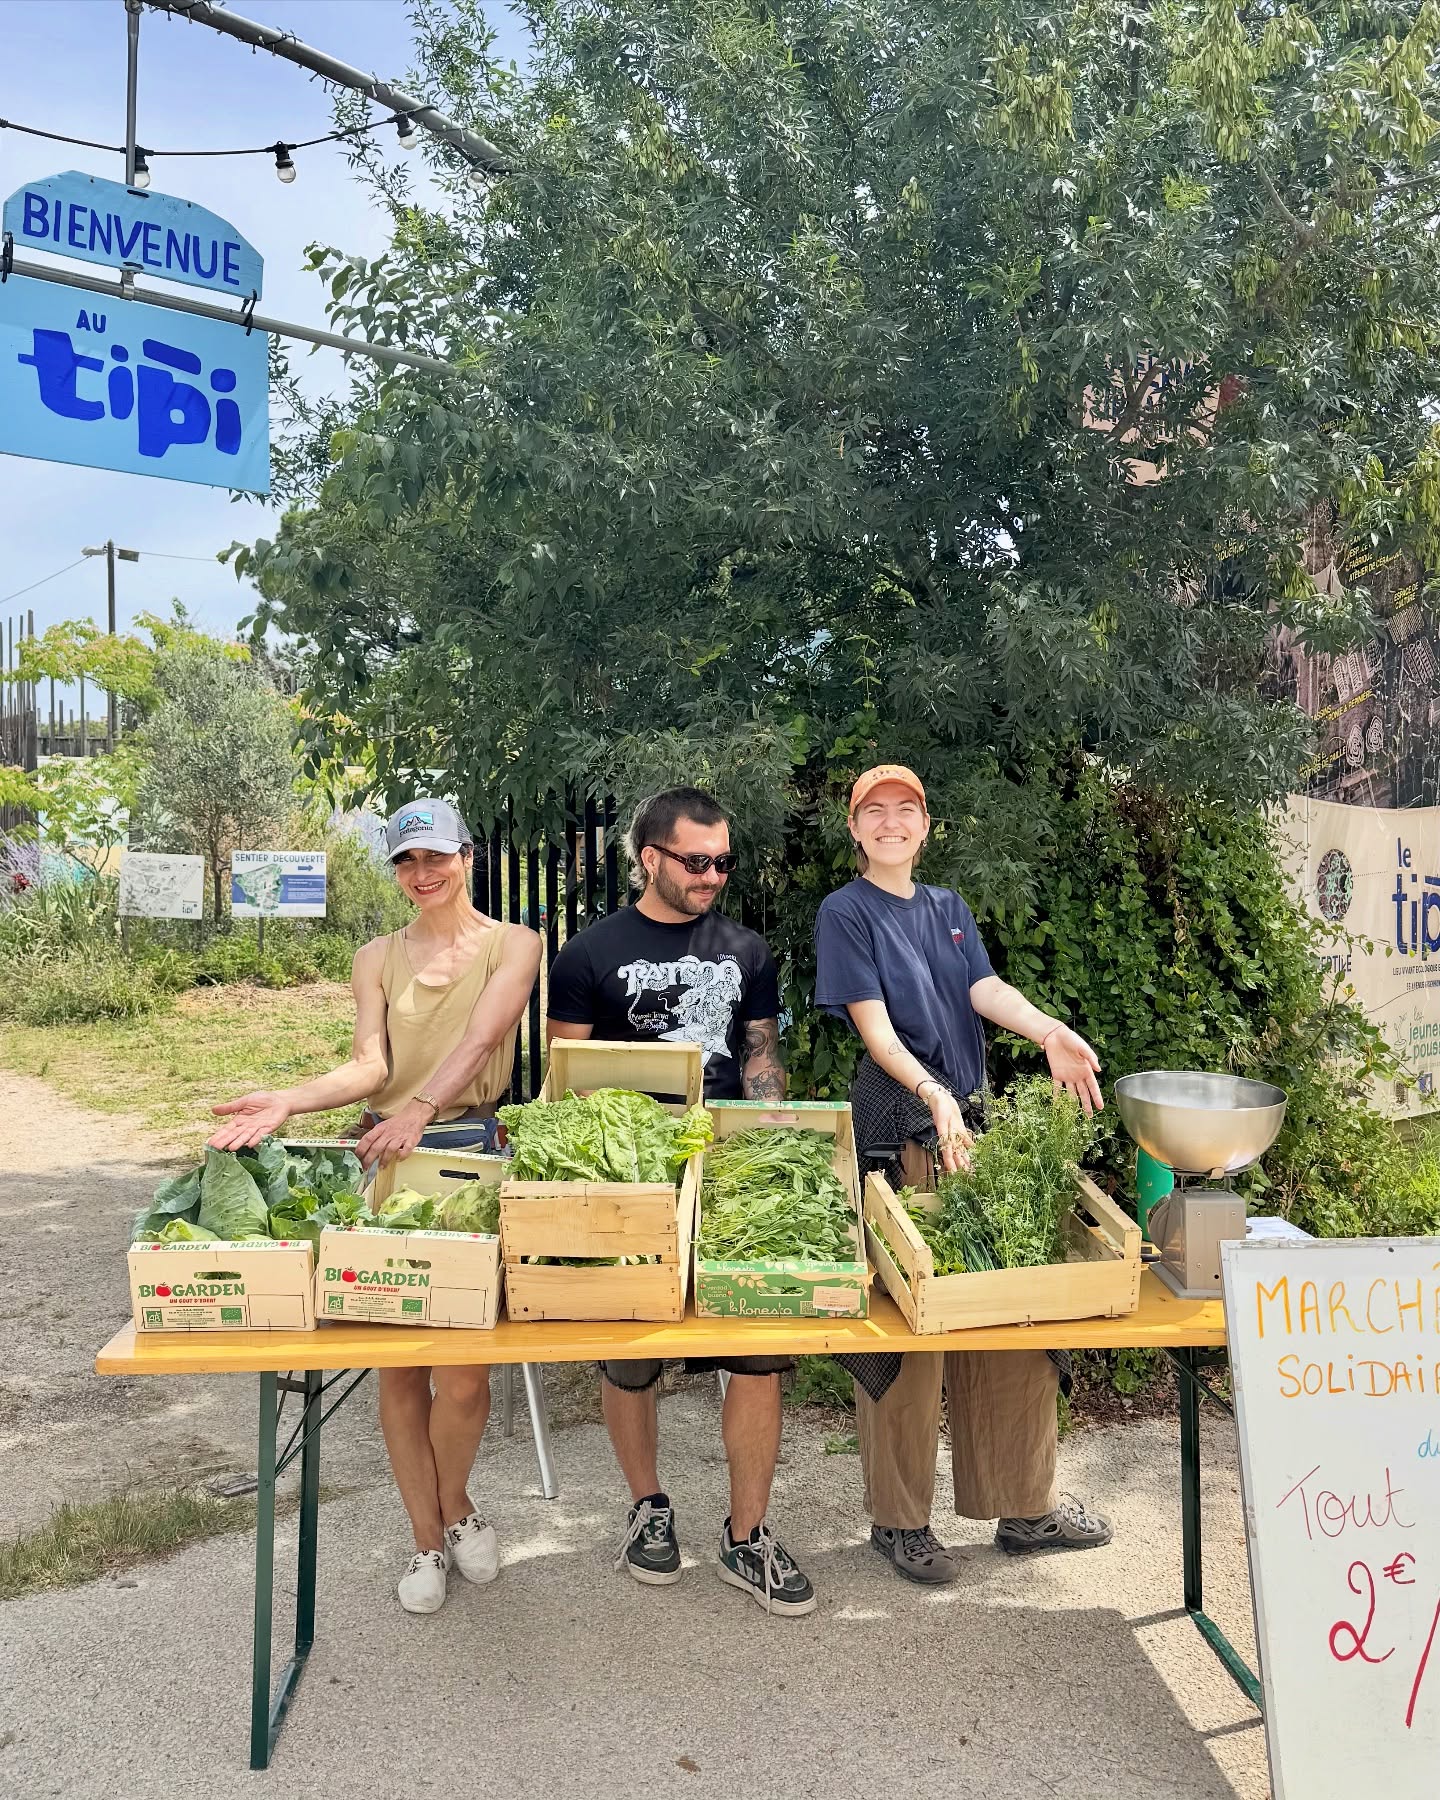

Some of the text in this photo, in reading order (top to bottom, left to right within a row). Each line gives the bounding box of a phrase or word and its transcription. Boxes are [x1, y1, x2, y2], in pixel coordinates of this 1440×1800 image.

[23, 192, 241, 285] BIENVENUE
[76, 309, 107, 333] AU
[18, 328, 242, 458] tipi
[235, 853, 325, 864] SENTIER DECOUVERTE
[1397, 837, 1412, 867] le
[1316, 954, 1352, 974] ERTILE
[1408, 1022, 1440, 1045] jeune
[1413, 1040, 1440, 1064] pous
[729, 1298, 793, 1315] la honesta
[1276, 1465, 1416, 1540] Tout
